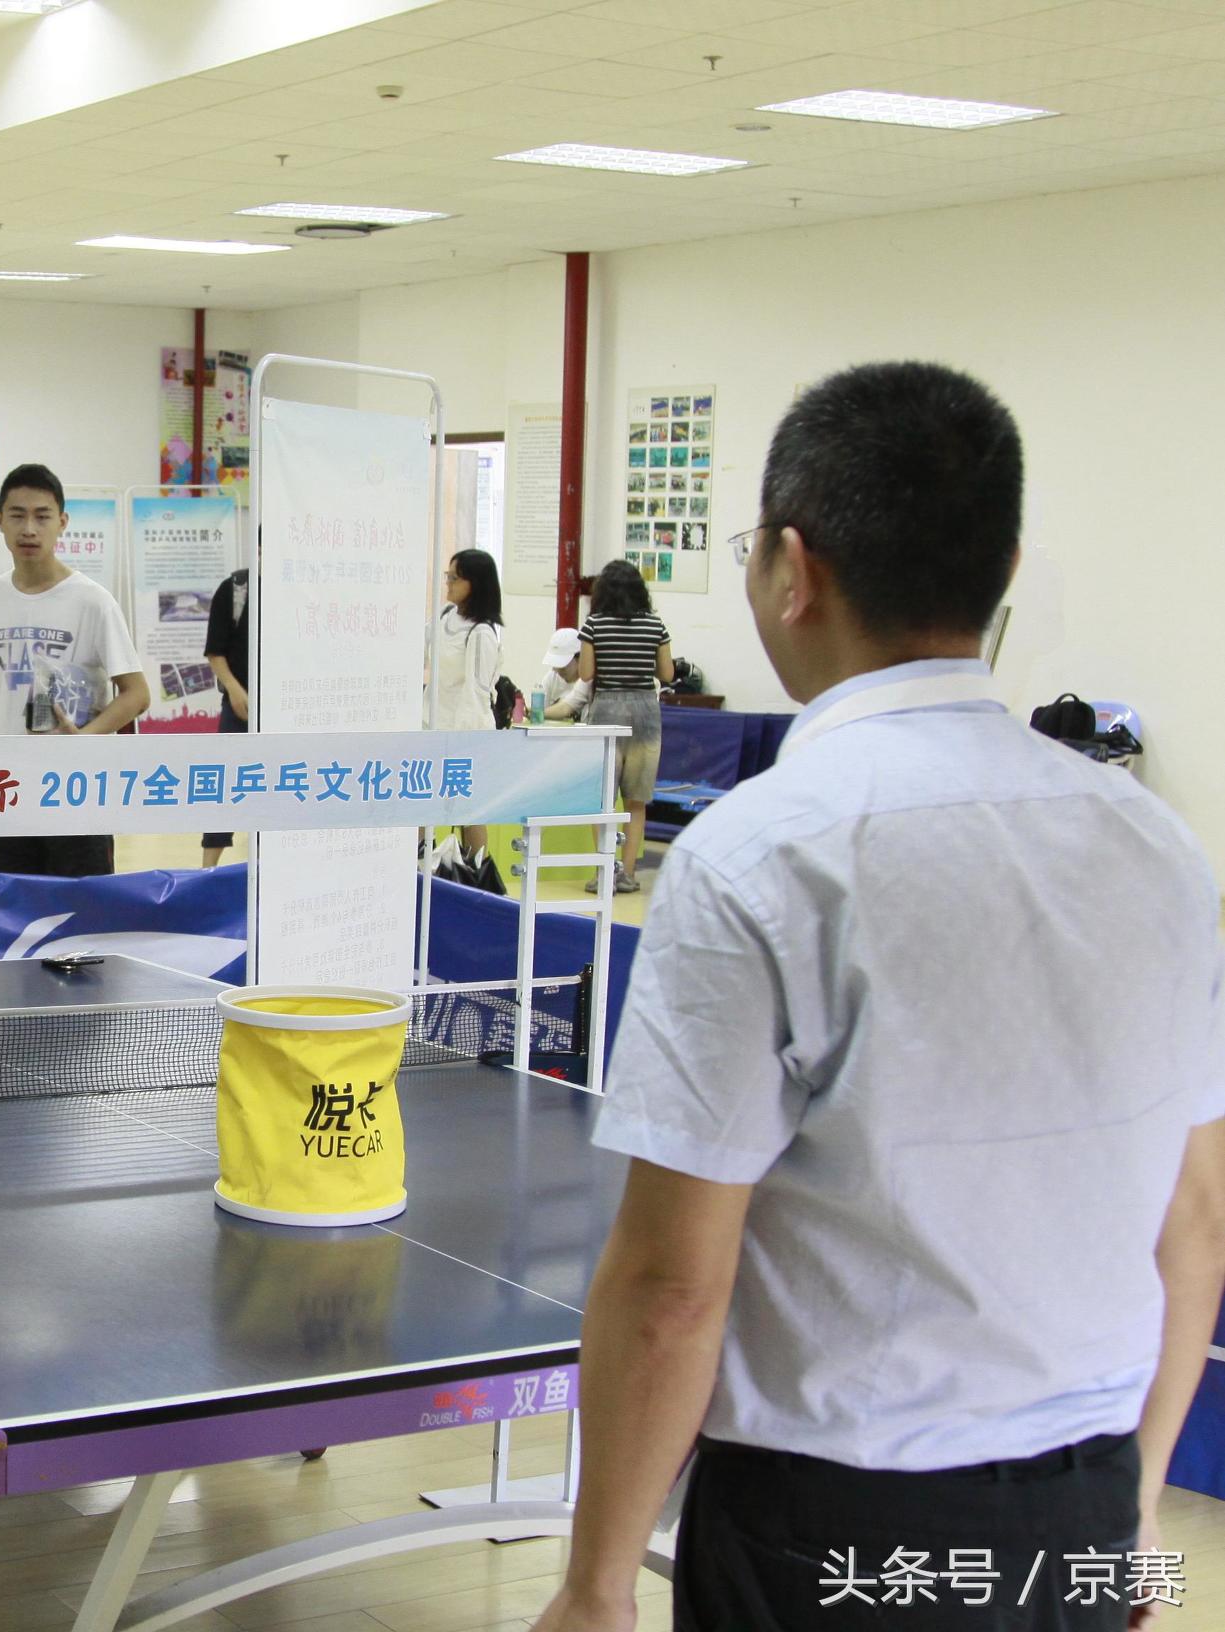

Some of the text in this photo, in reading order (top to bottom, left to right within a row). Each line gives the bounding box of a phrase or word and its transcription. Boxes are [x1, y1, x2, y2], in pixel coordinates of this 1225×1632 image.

[38, 629, 65, 641] ONE
[39, 756, 474, 808] 2017全国乒乓文化巡展
[300, 1129, 383, 1158] YUECAR
[508, 1370, 571, 1416] 双鱼
[420, 1407, 495, 1427] DOUBLE FISH
